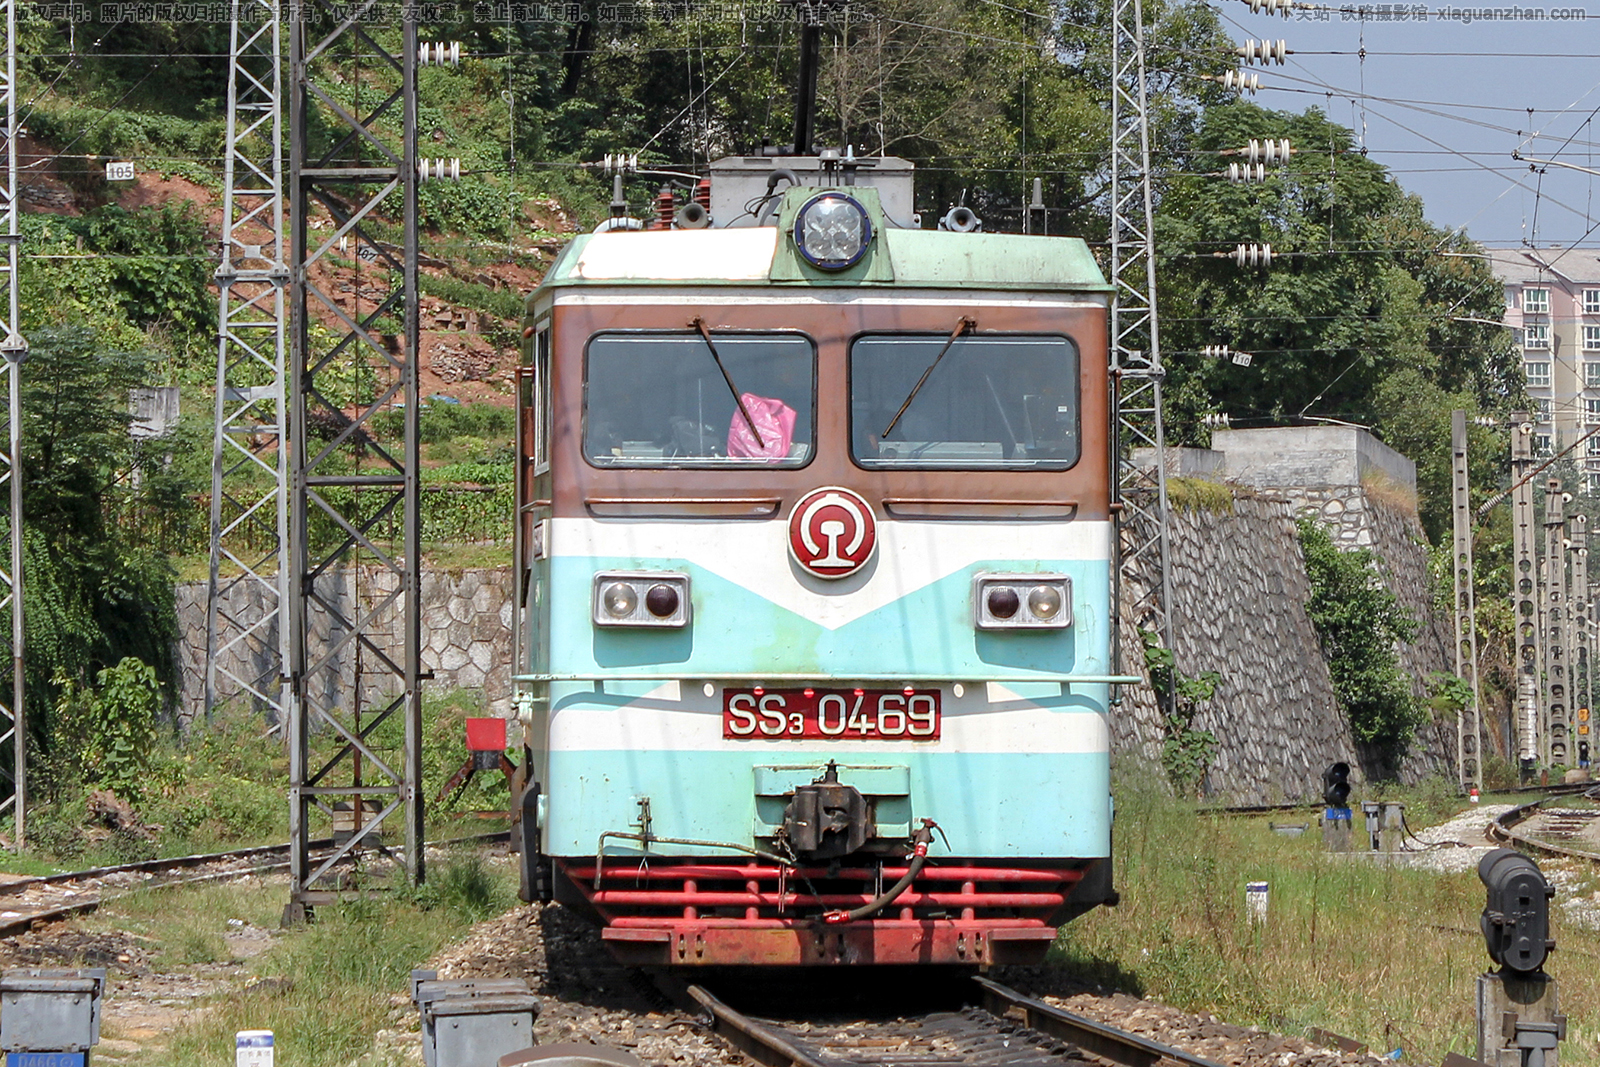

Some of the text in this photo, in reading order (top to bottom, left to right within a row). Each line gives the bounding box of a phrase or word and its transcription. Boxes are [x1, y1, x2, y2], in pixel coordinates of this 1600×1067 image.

[110, 166, 132, 178] 105
[1235, 355, 1250, 366] 110
[728, 693, 936, 735] SS3 0469
